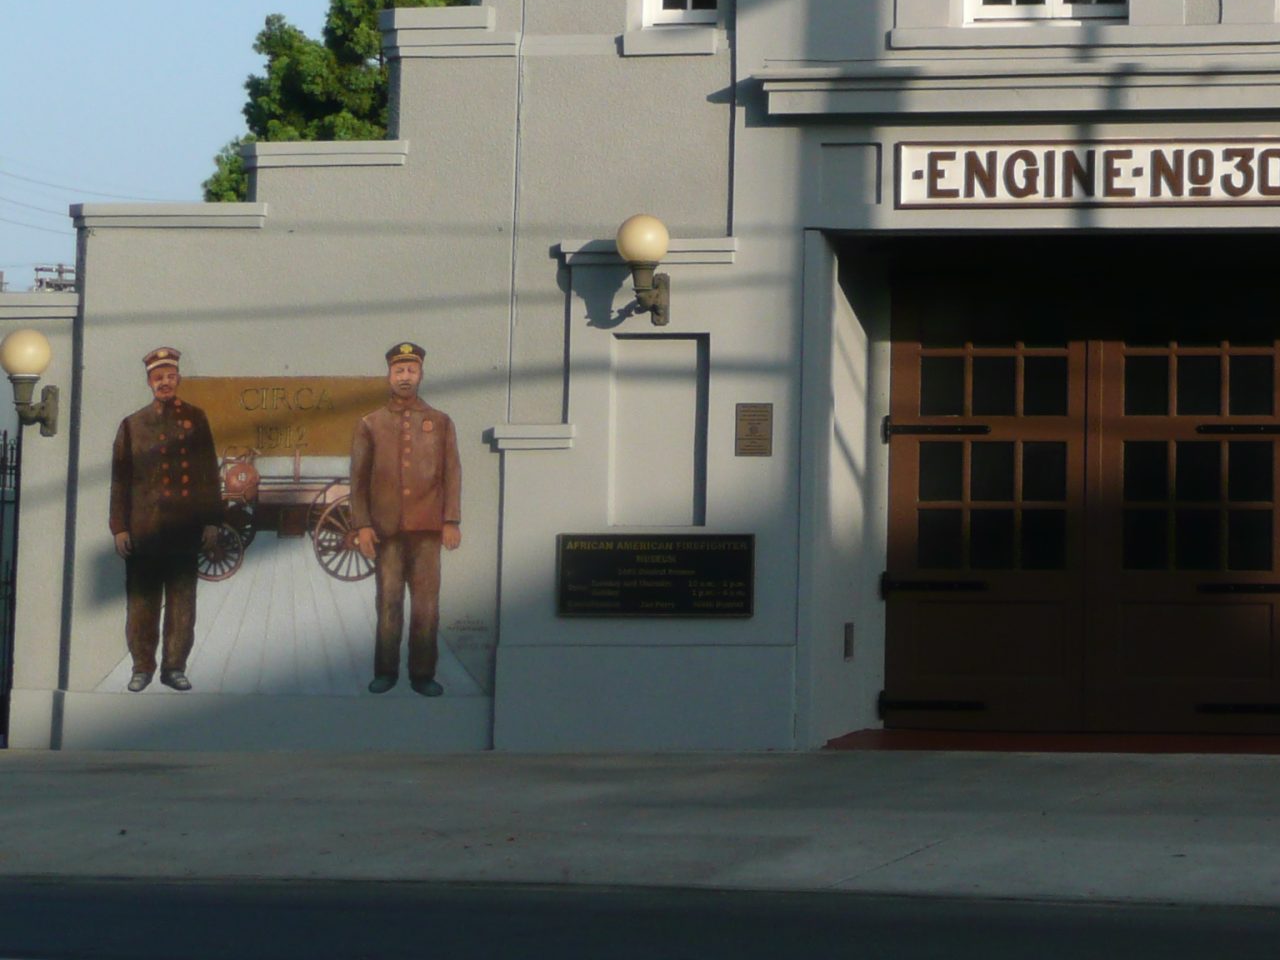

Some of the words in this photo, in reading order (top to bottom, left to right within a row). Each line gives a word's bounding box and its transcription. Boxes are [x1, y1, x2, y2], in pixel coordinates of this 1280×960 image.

[926, 149, 1137, 199] ENGINE
[240, 387, 335, 411] CIRCA
[256, 424, 309, 450] 1912
[566, 540, 614, 551] AFRICAN
[616, 540, 674, 551] AMERICAN
